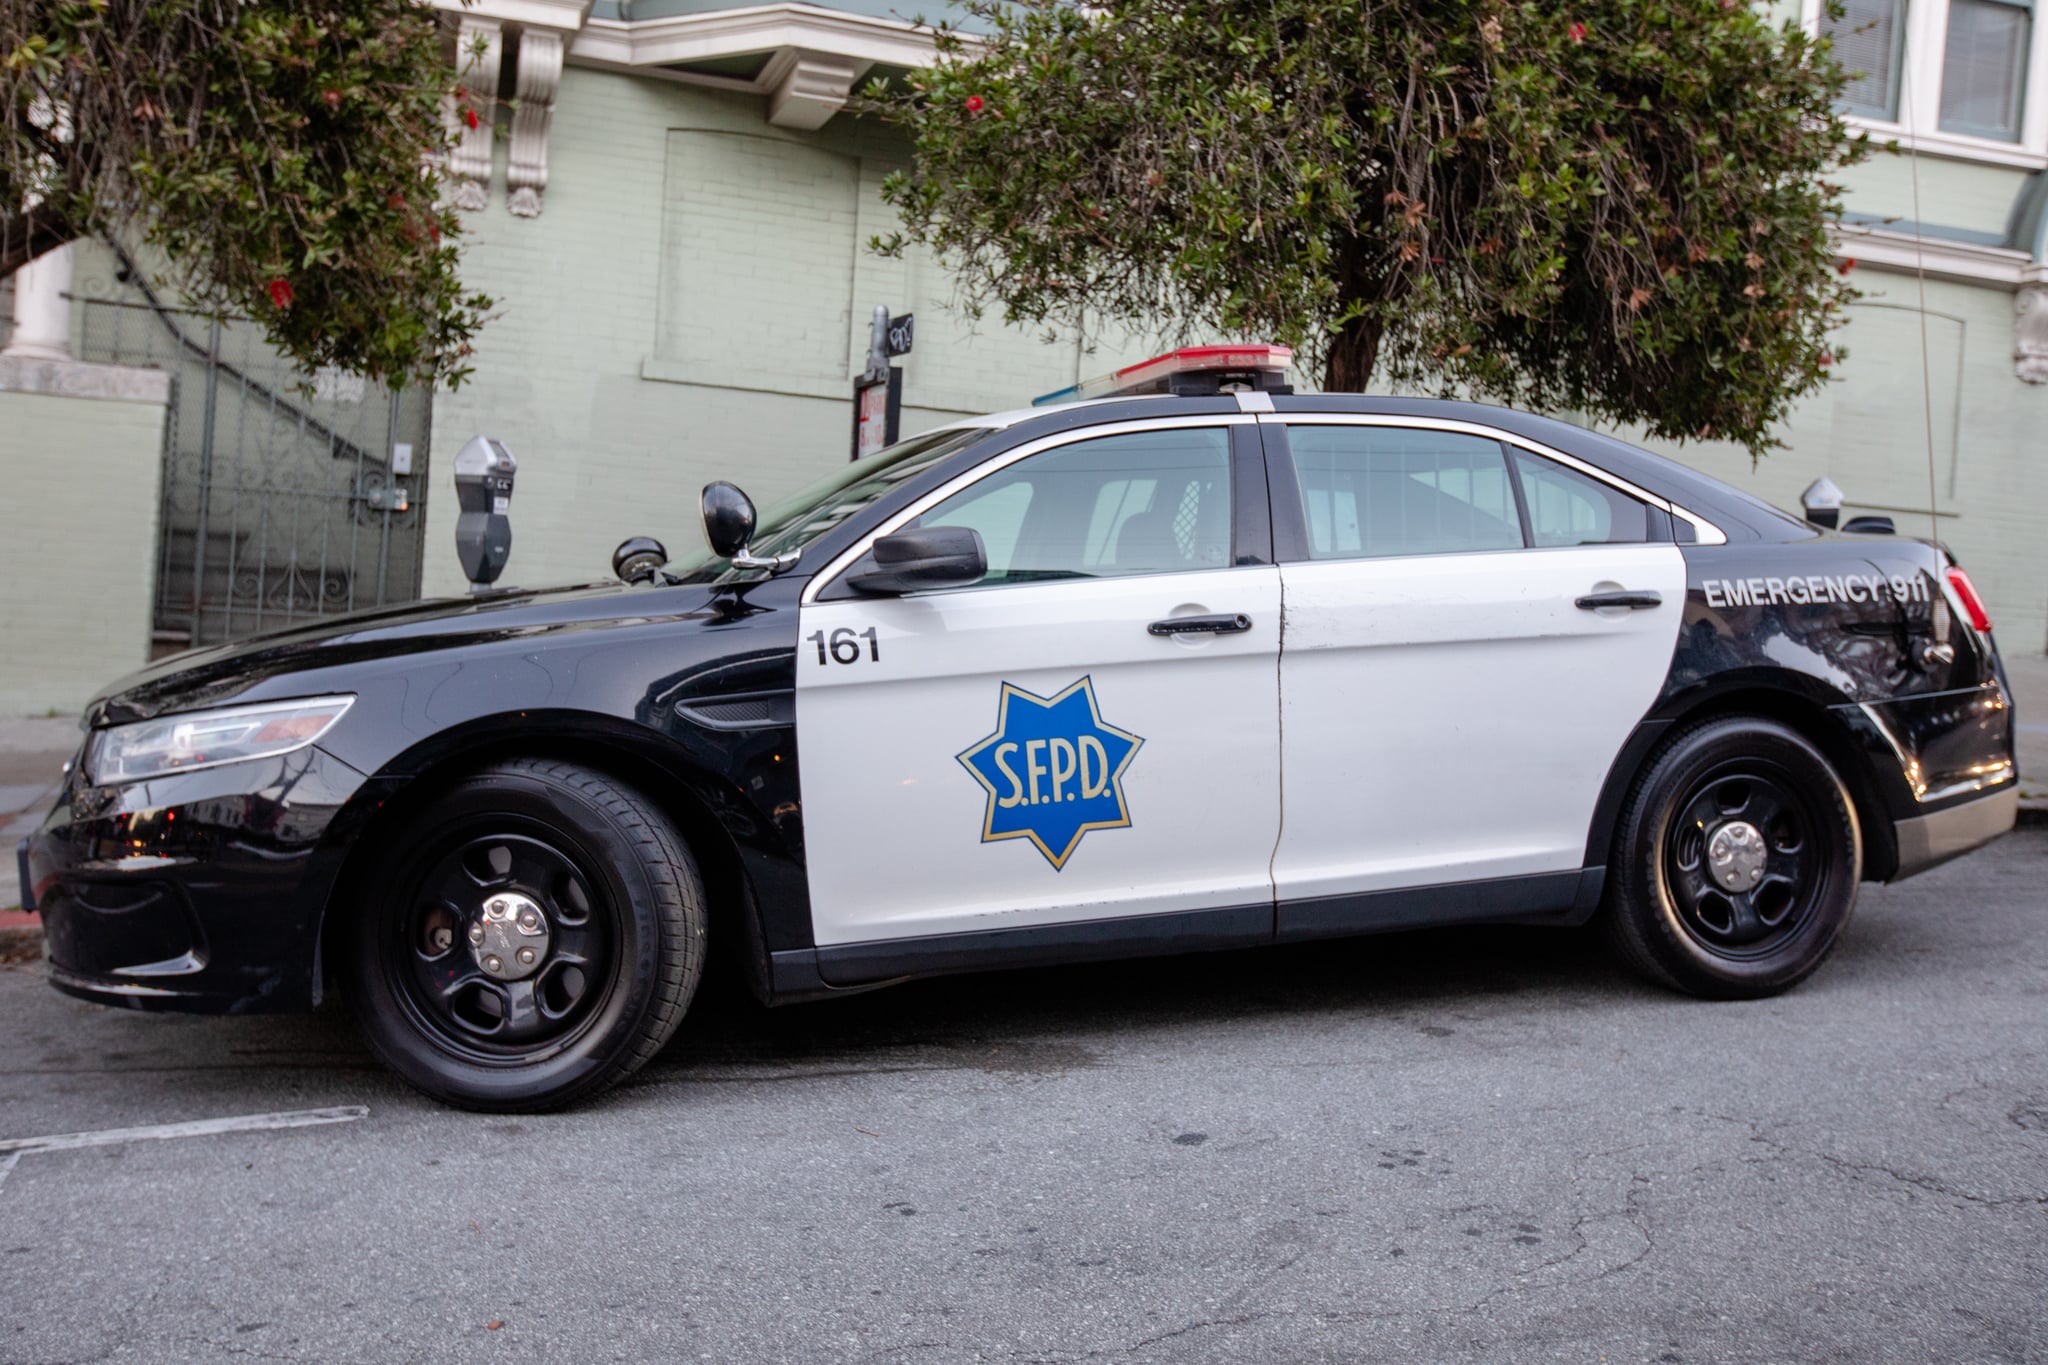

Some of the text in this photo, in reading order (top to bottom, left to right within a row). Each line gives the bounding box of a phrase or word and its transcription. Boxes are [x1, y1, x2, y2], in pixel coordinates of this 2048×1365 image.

[1702, 572, 1931, 608] EMERGENCY 911
[806, 626, 879, 666] 161
[994, 735, 1111, 808] S.F.P.D.
